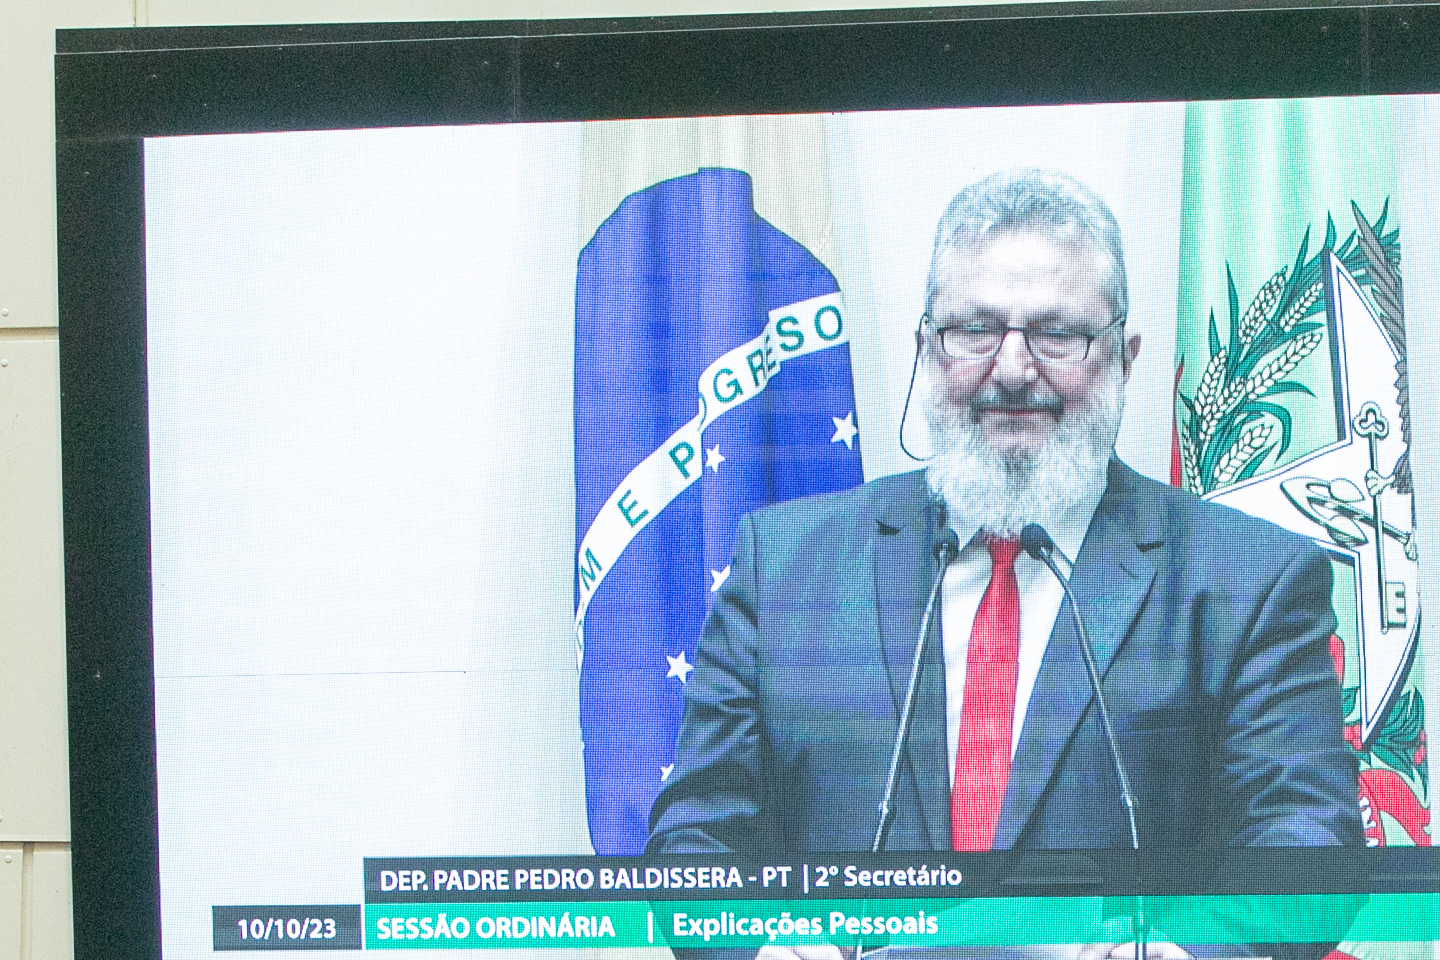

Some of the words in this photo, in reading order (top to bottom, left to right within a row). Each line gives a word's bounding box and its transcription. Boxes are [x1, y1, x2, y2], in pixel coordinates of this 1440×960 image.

[380, 869, 428, 892] DEP.
[433, 869, 510, 891] PADRE
[515, 868, 595, 891] PEDRO
[599, 866, 744, 890] BALDISSERA
[762, 866, 793, 888] PT
[843, 864, 963, 888] Secretário
[237, 917, 337, 941] 10/10/23
[376, 912, 471, 940] SESSÃO
[475, 911, 616, 940] ORDINÁRIA
[672, 911, 823, 942] Explicações
[829, 910, 939, 936] Pessoais
